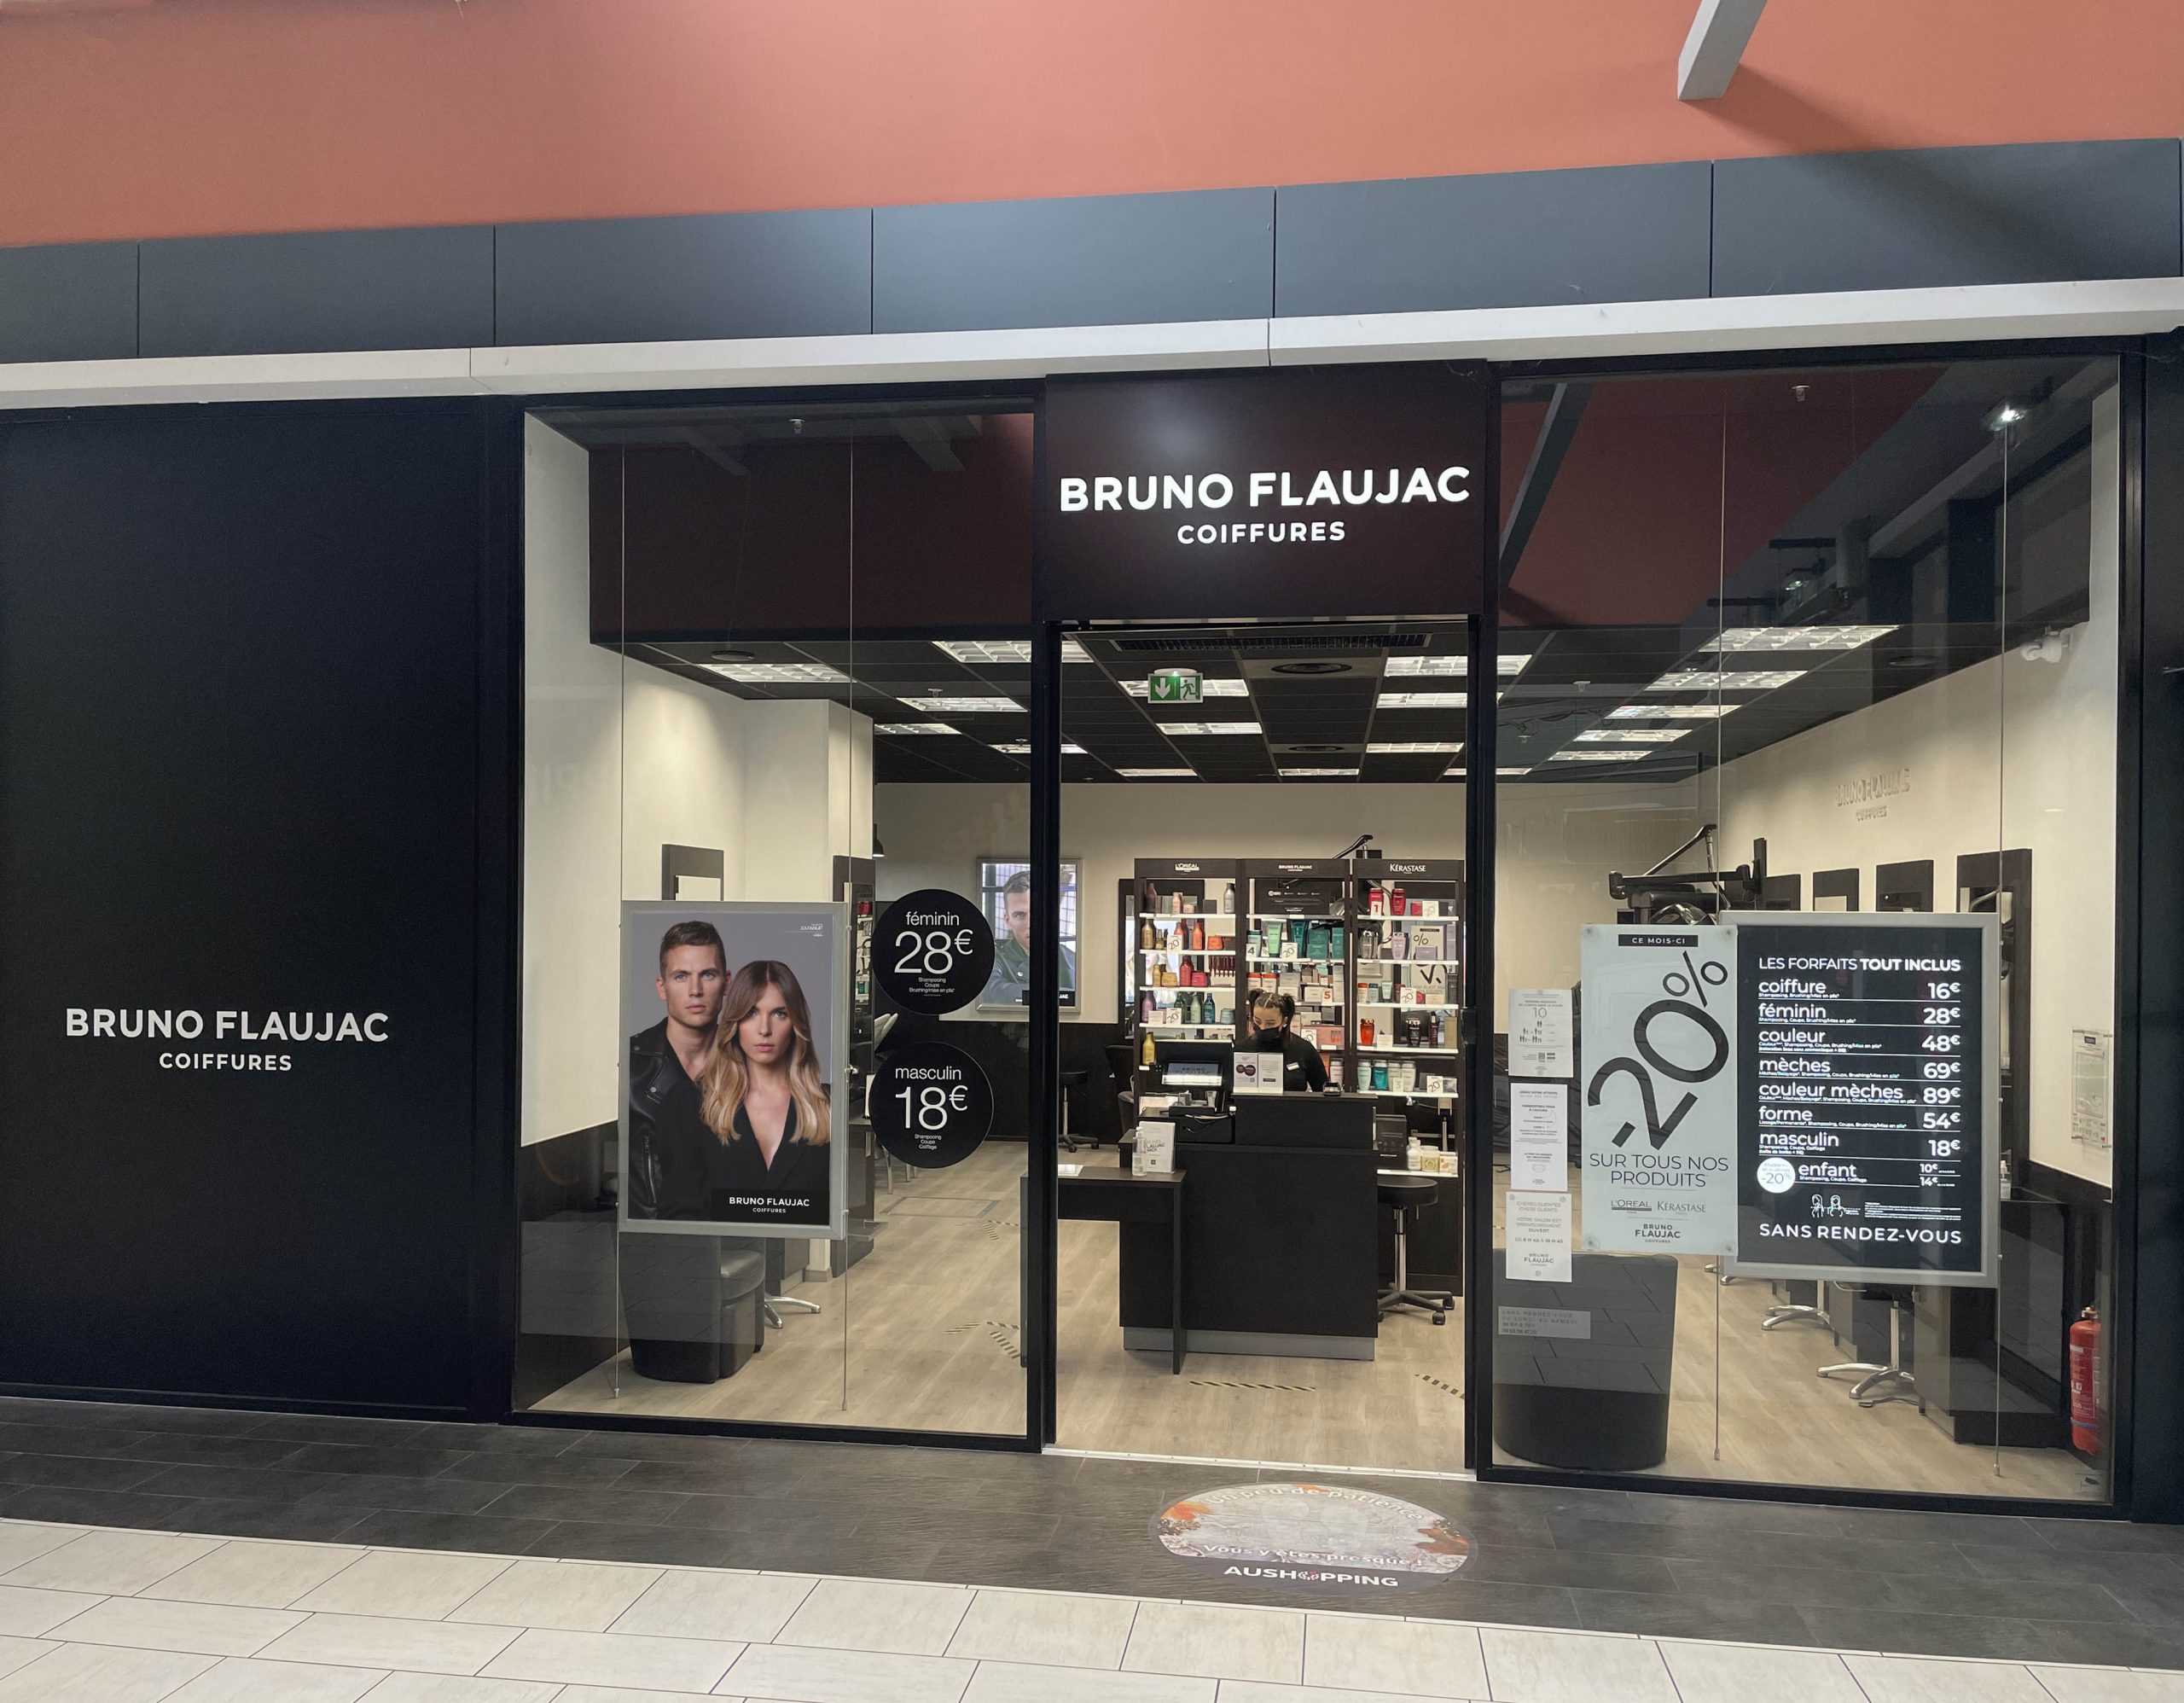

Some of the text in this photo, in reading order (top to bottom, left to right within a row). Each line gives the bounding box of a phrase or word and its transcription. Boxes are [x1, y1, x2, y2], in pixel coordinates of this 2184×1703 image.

[1060, 466, 1470, 512] BRUNO FLAUJAC
[1177, 521, 1345, 545] COIFFURES
[1390, 863, 1426, 872] KÉRASTASE
[906, 911, 960, 927] féminin
[894, 928, 973, 974] 28€
[1759, 957, 1961, 972] LES FORFAITS TOUT INCLUS
[1758, 979, 1960, 999] coiffure 16€
[1533, 1007, 1548, 1018] 10
[1758, 1003, 1960, 1025] féminin 28€
[66, 1008, 389, 1043] BRUNO FLAUJAC
[1758, 1027, 1960, 1052] couleur 48€
[1588, 950, 1729, 1151] -20%
[159, 1052, 292, 1072] COIFFURES
[1759, 1056, 1960, 1079] mèches 69€
[896, 1066, 961, 1081] masculin
[1759, 1081, 1960, 1104] couleur mèches 89€
[895, 1084, 969, 1130] 18€
[1758, 1106, 1960, 1130] forme 54€
[1760, 1131, 1960, 1156] masculin 18€
[1589, 1154, 1729, 1171] SUR TOUS NOS
[1798, 1161, 1856, 1177] enfant
[1920, 1163, 1938, 1173] 10€
[1611, 1171, 1706, 1188] PRODUITS
[1920, 1177, 1938, 1187] 14€
[729, 1196, 810, 1206] BRUNO FLAUJAC
[1635, 1229, 1681, 1239] FLAUJAC
[1759, 1223, 1961, 1244] SANS RENDEZ-VOUS
[1205, 1486, 1425, 1521] Un peu de patience
[1203, 1544, 1252, 1555] Vous
[1327, 1553, 1410, 1566] presque
